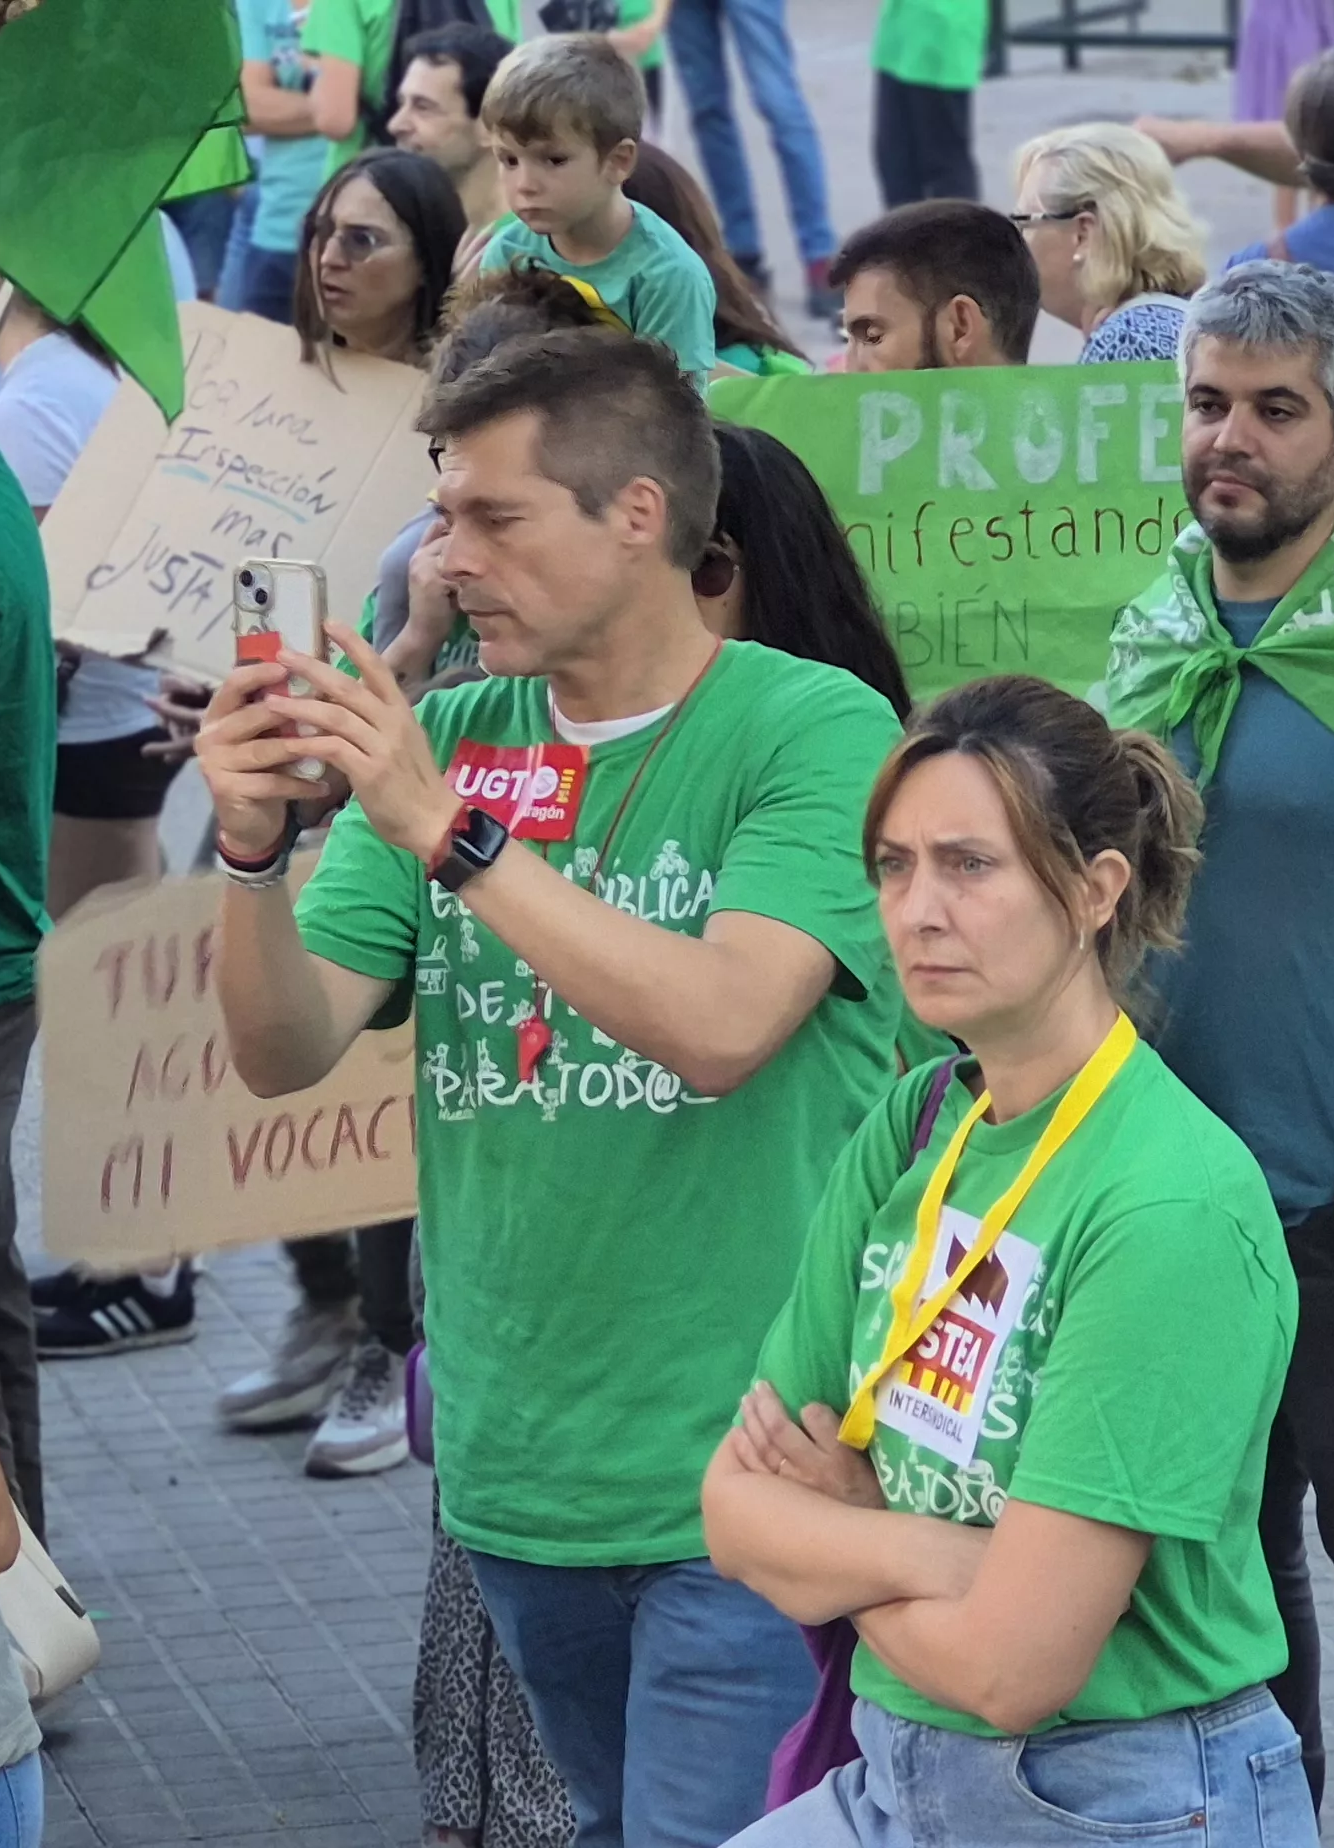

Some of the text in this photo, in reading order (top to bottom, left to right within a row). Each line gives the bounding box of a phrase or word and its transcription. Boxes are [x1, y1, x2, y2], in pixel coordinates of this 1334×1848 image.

[455, 764, 531, 801] UGT
[456, 981, 505, 1023] DE
[558, 1060, 719, 1113] TOD@
[101, 1134, 174, 1212] MI
[918, 1317, 983, 1382] STEA
